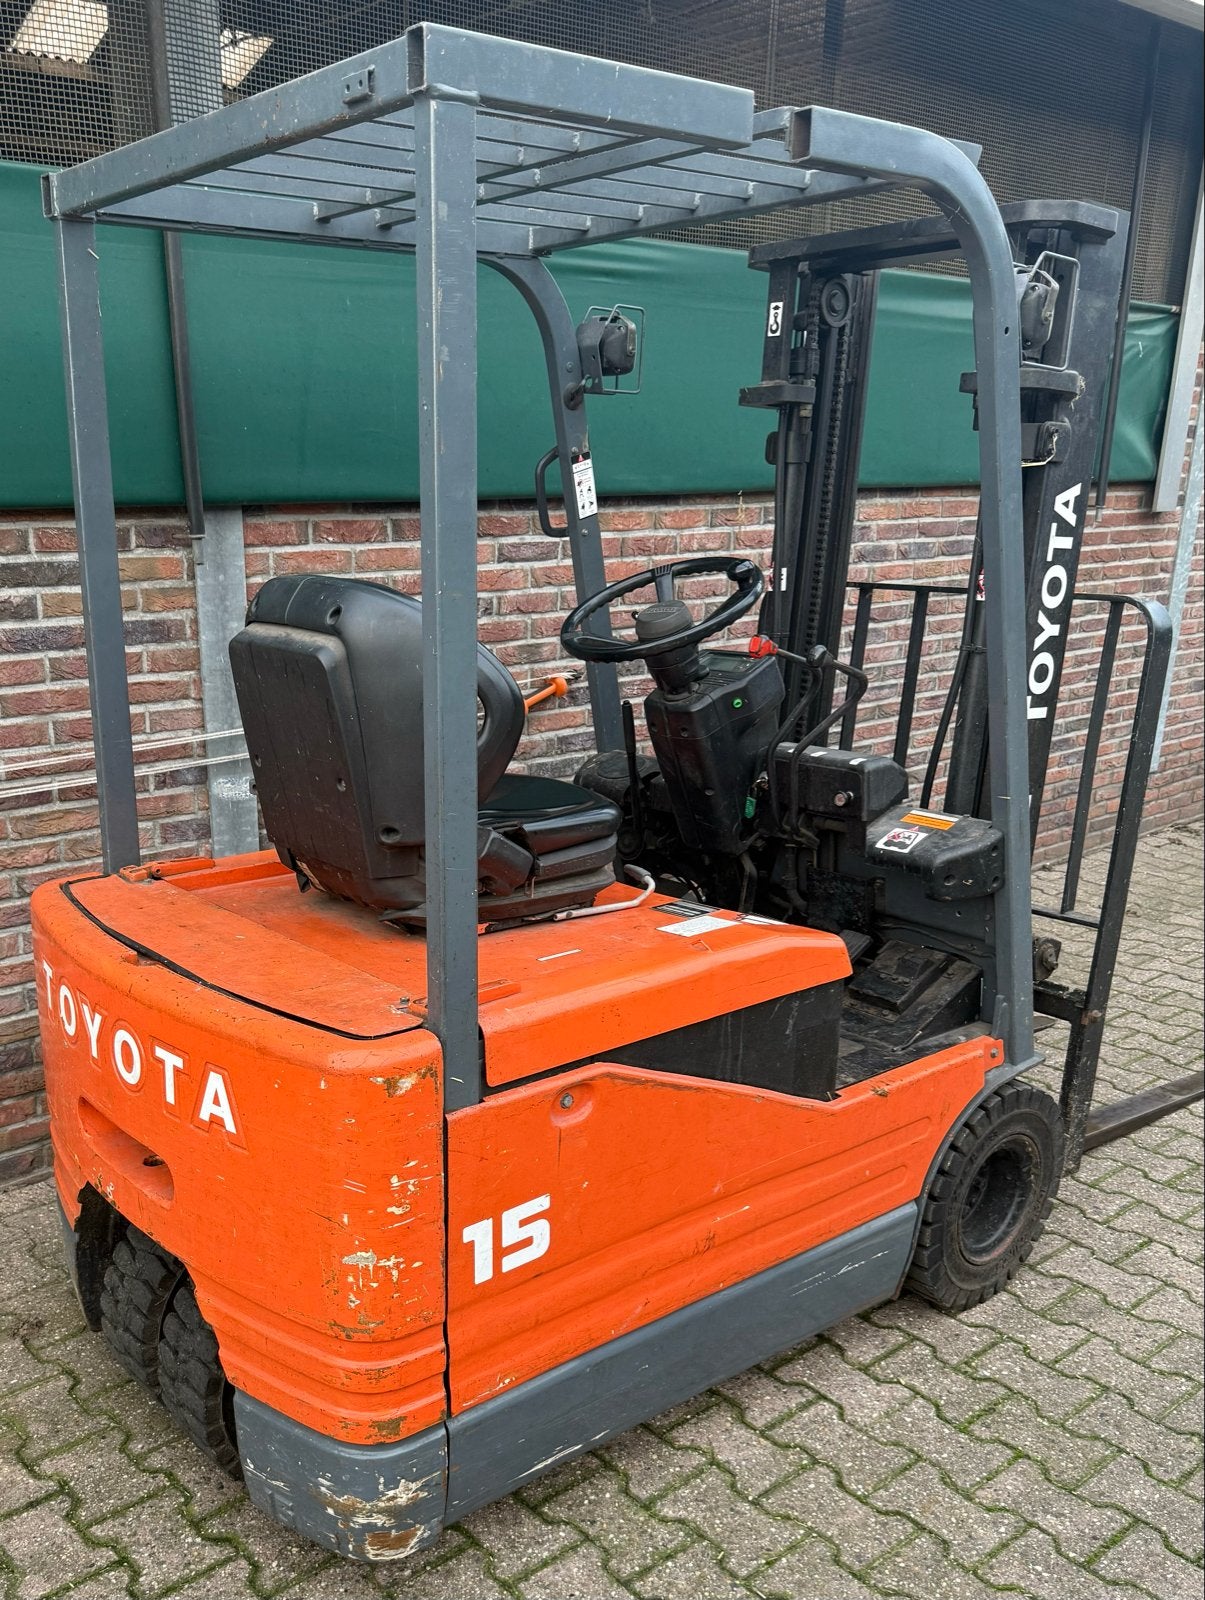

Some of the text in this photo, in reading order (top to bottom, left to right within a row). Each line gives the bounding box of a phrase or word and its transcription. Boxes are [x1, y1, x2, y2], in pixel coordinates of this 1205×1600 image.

[1026, 482, 1083, 720] TOYOTA
[42, 960, 237, 1134] TOYOTA
[462, 1193, 551, 1285] 15
